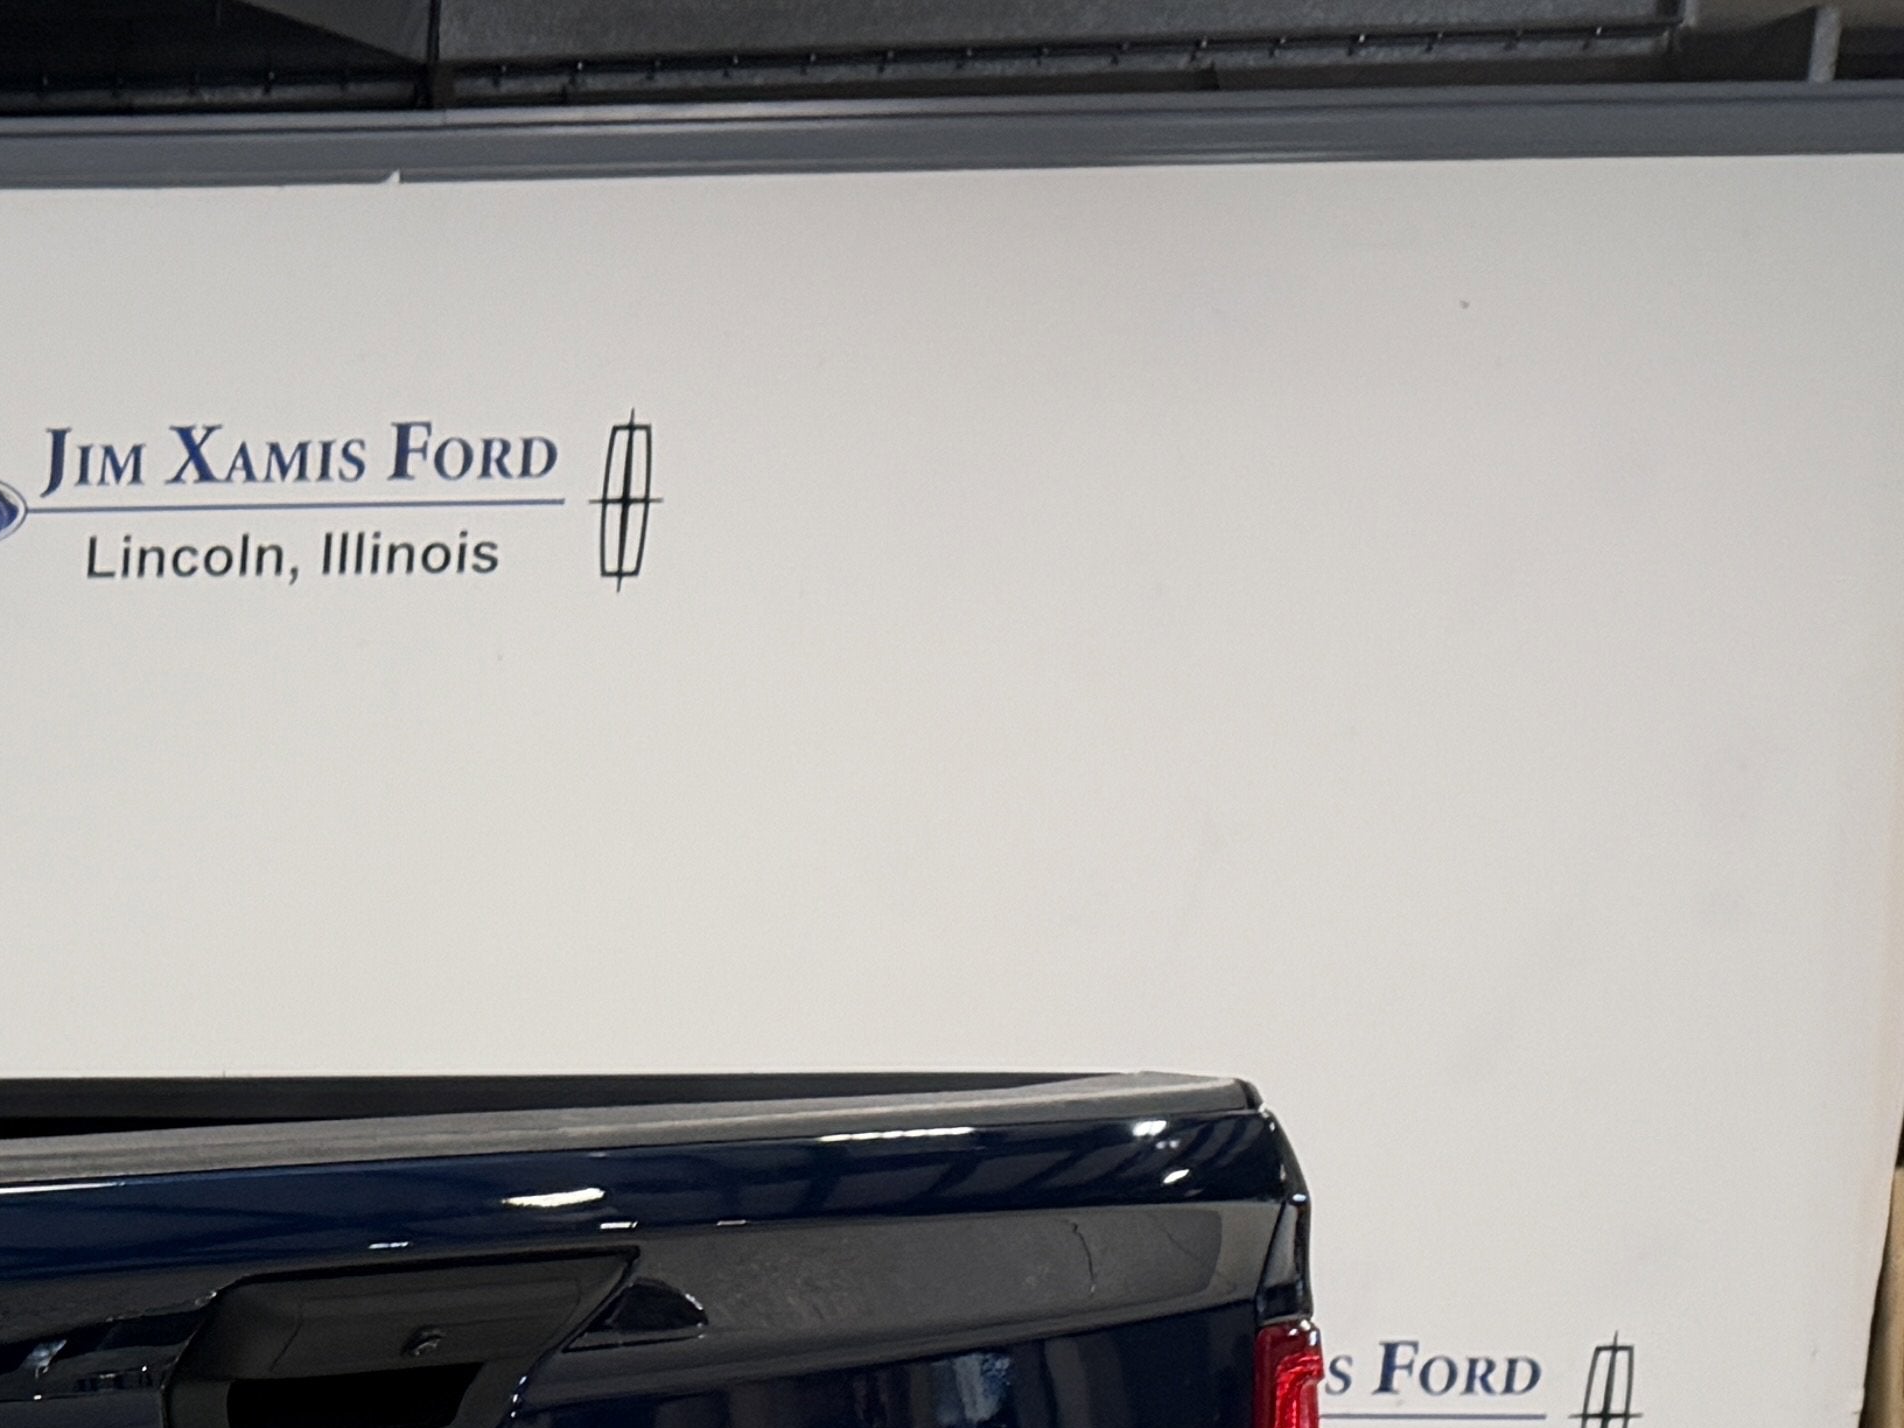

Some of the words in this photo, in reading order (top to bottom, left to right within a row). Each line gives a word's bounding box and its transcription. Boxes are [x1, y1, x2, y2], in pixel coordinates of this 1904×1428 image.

[40, 426, 146, 498] JIM
[164, 423, 367, 485] XAMIS
[387, 421, 558, 482] FORD
[87, 532, 299, 586] Lincoln,
[322, 531, 499, 576] Illinois
[1371, 1339, 1542, 1397] FORD
